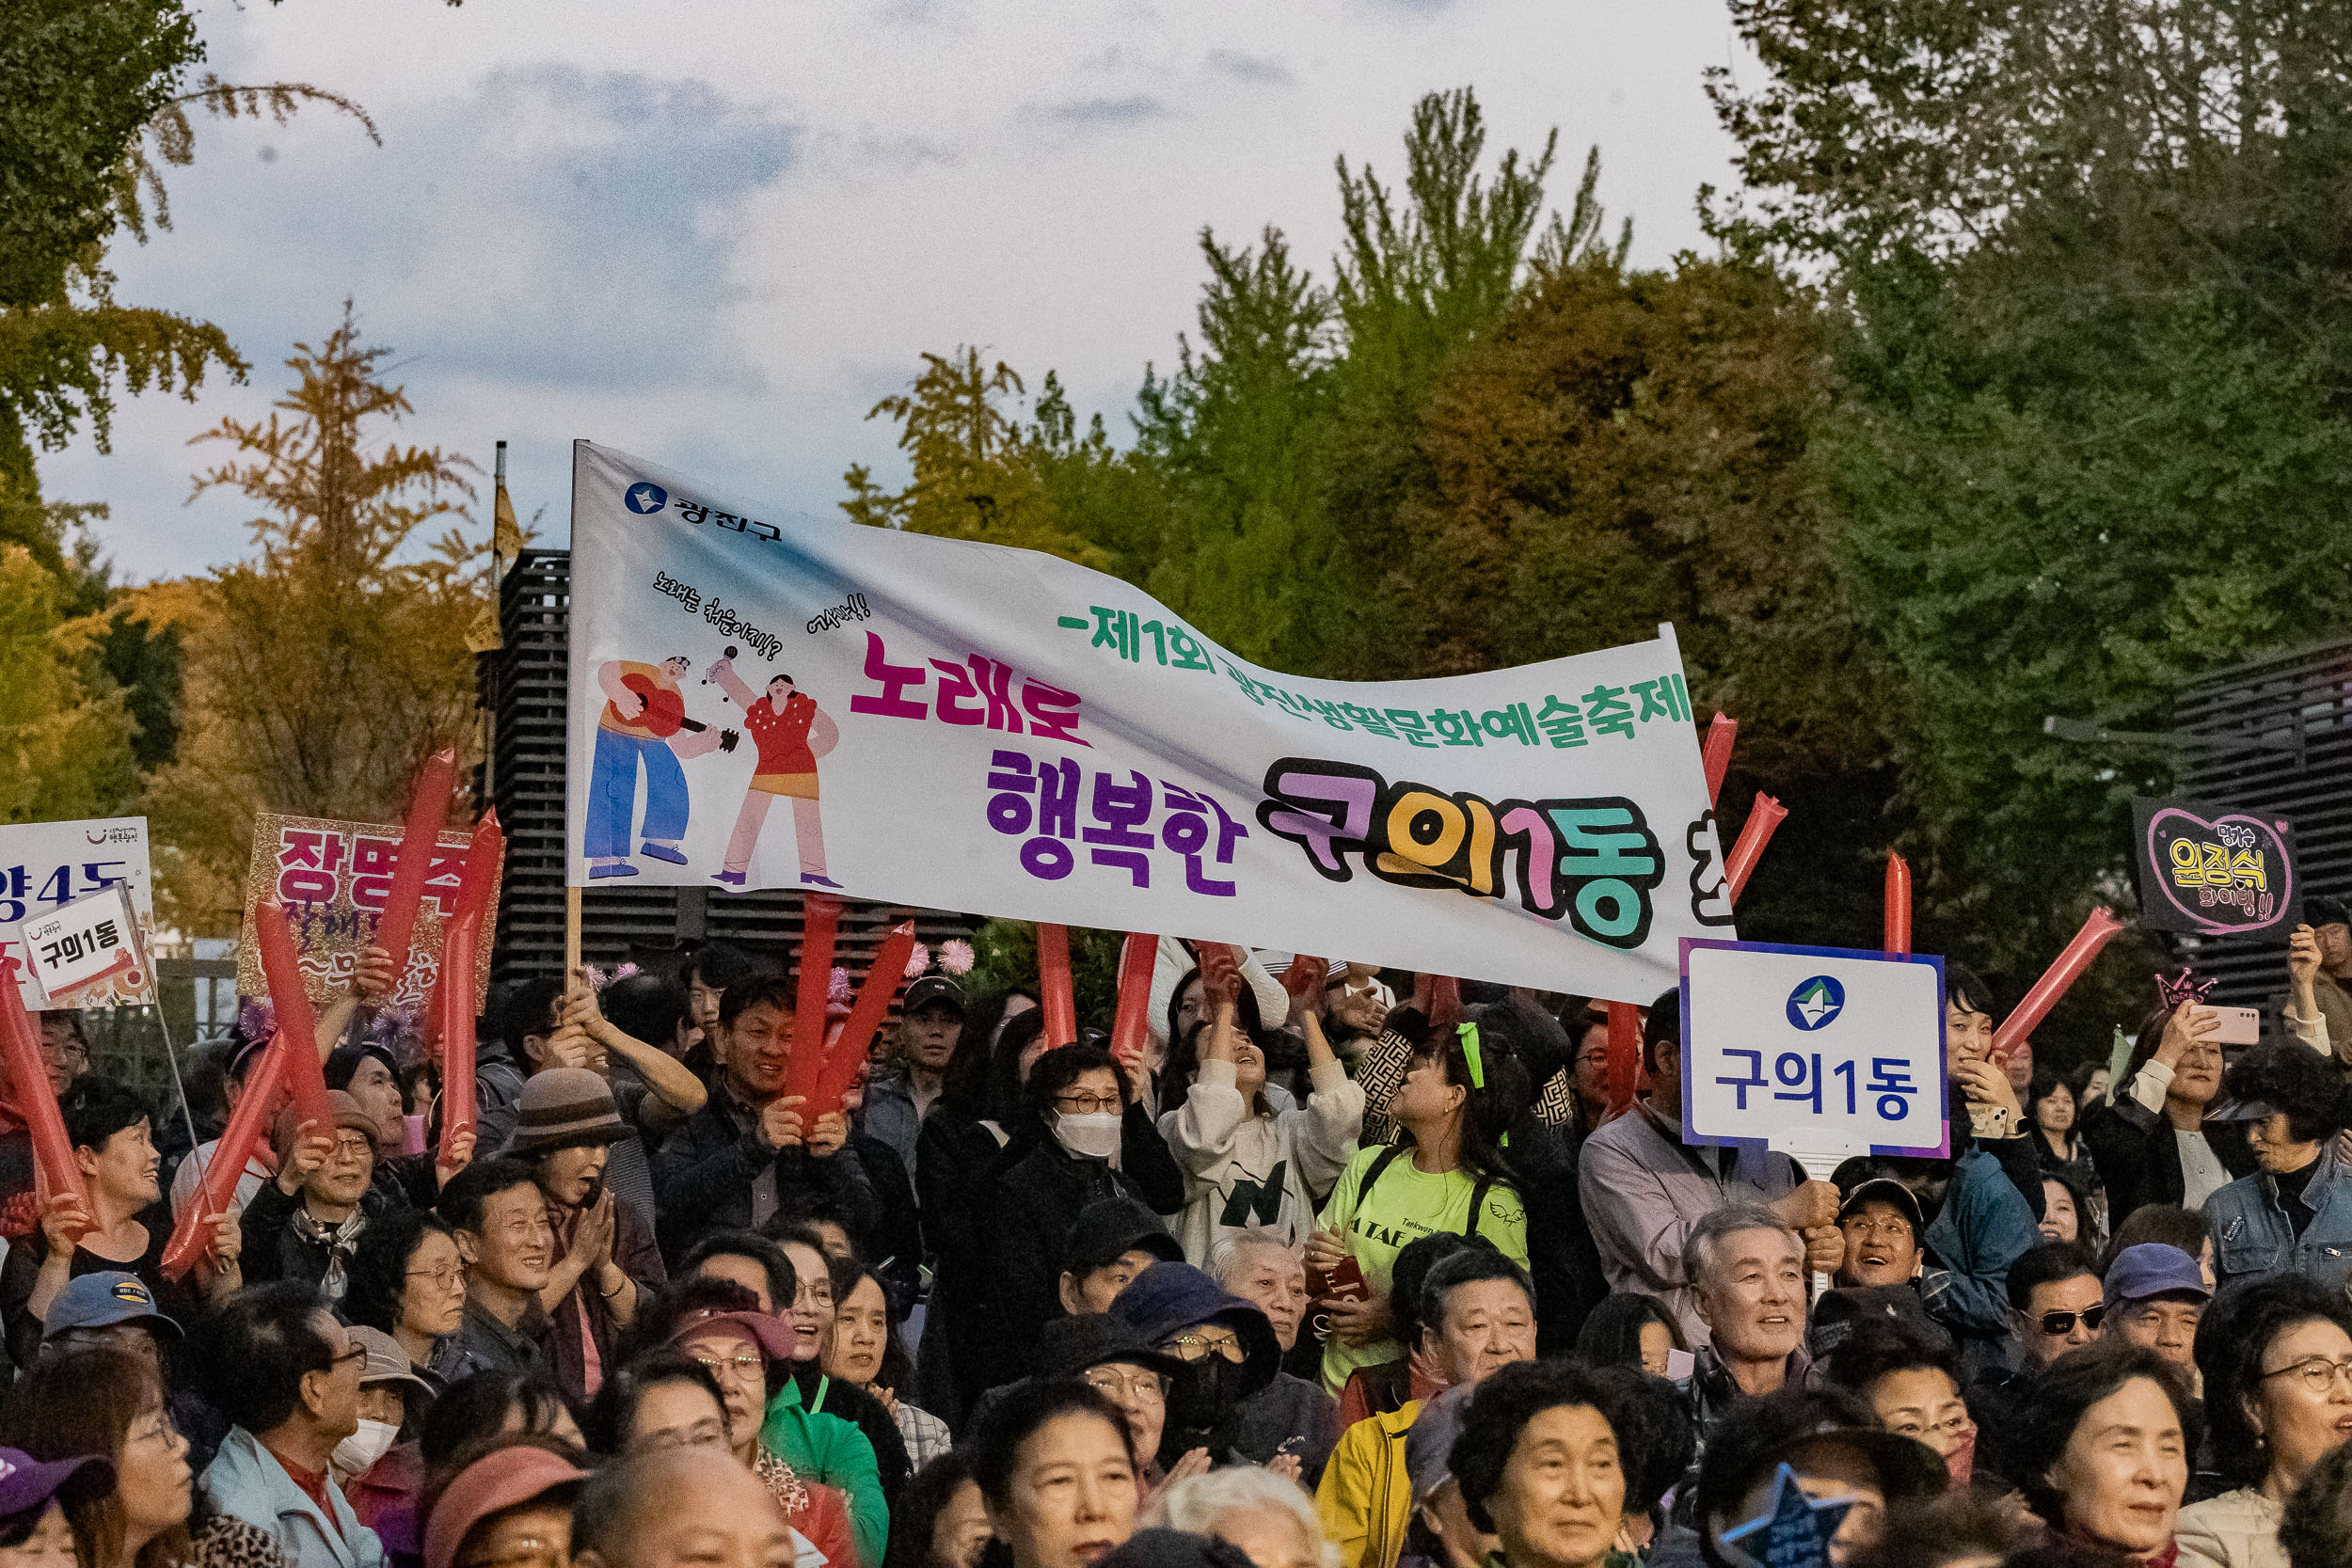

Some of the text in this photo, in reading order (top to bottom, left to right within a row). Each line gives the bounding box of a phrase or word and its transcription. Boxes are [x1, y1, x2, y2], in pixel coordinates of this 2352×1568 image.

[675, 499, 783, 542] 광진구
[653, 571, 702, 613] 노래는
[850, 629, 1095, 750] 노래로
[986, 749, 1250, 897] 행복한
[1255, 756, 1666, 949] 구의1동
[2217, 824, 2256, 848] 명가수
[2169, 837, 2267, 893] 원정식
[40, 919, 119, 970] 구의1동
[1716, 1048, 1918, 1120] 구의1동
